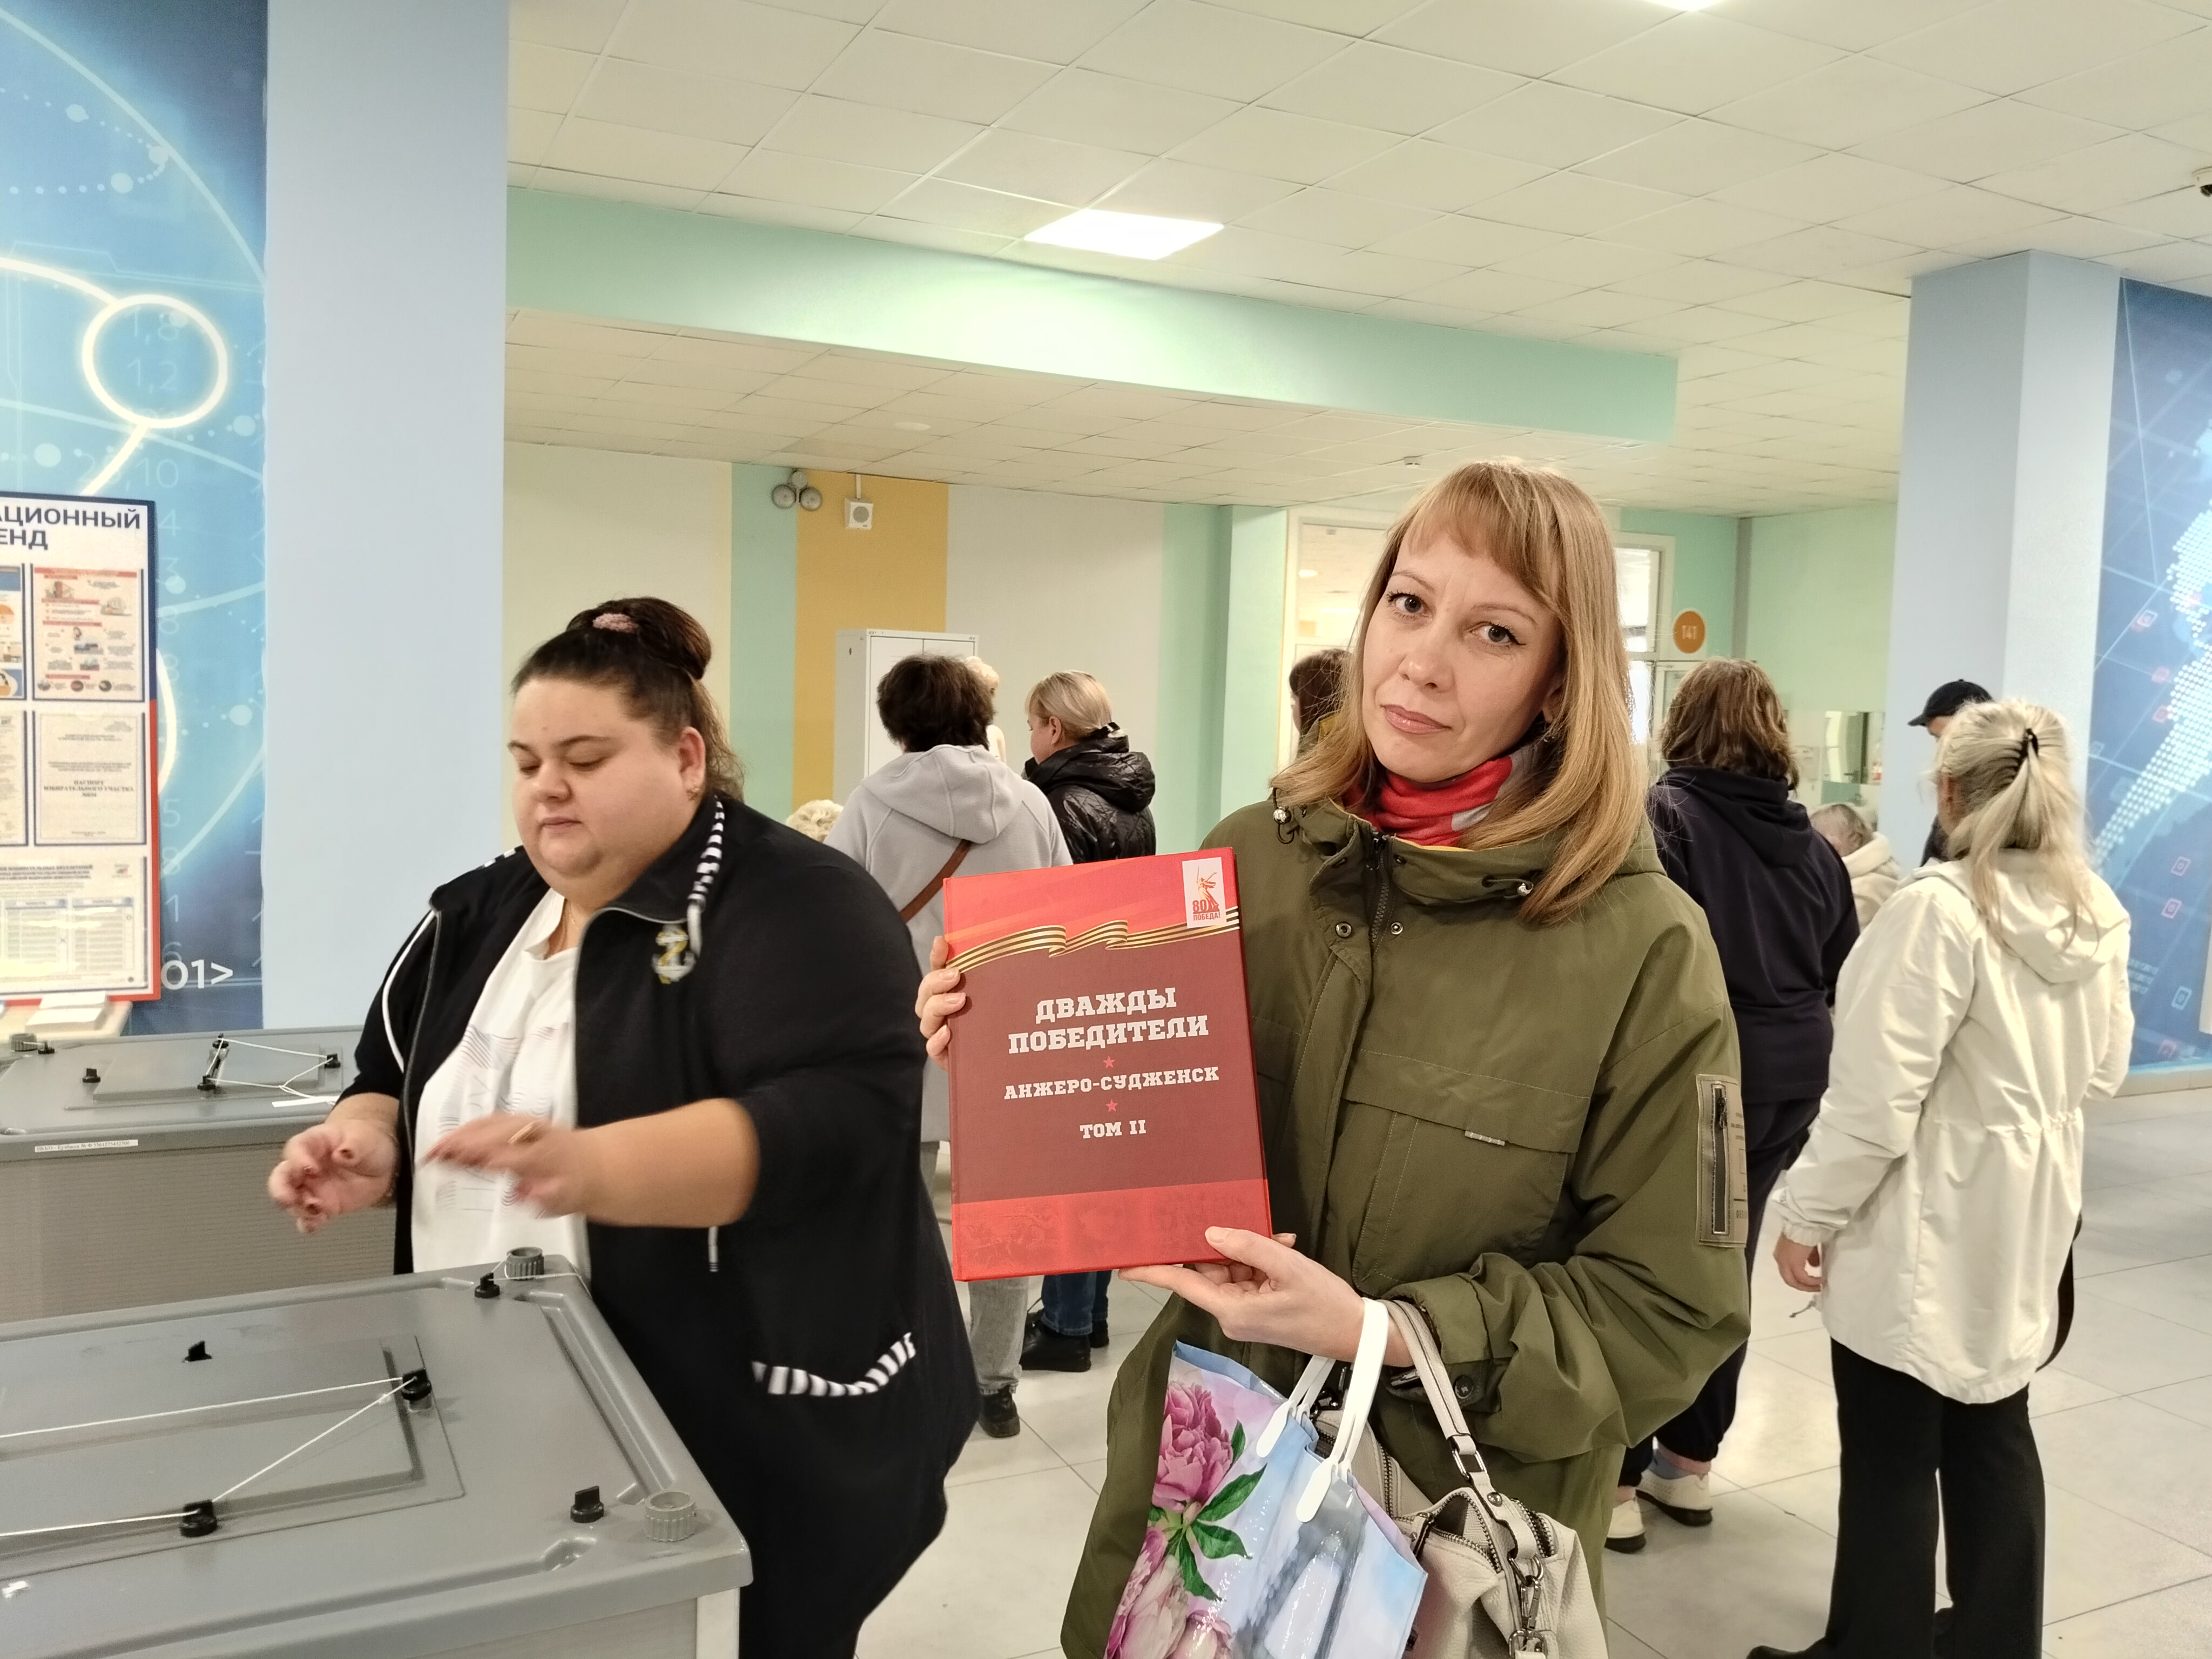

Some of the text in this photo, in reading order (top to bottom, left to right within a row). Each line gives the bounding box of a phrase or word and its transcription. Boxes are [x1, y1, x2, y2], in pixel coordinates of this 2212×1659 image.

[0, 505, 140, 529] ЦИОННЫЙ
[1192, 899, 1208, 913] 80
[1193, 912, 1220, 921] ПОБЕДА!
[1035, 987, 1177, 1024] ДВАЖДЫ
[1008, 1015, 1209, 1054] ПОБЕДИТЕЛИ
[1004, 1067, 1219, 1100] АНЖЕРО-СУДЖЕНСК
[1080, 1120, 1147, 1139] ТОМ II
